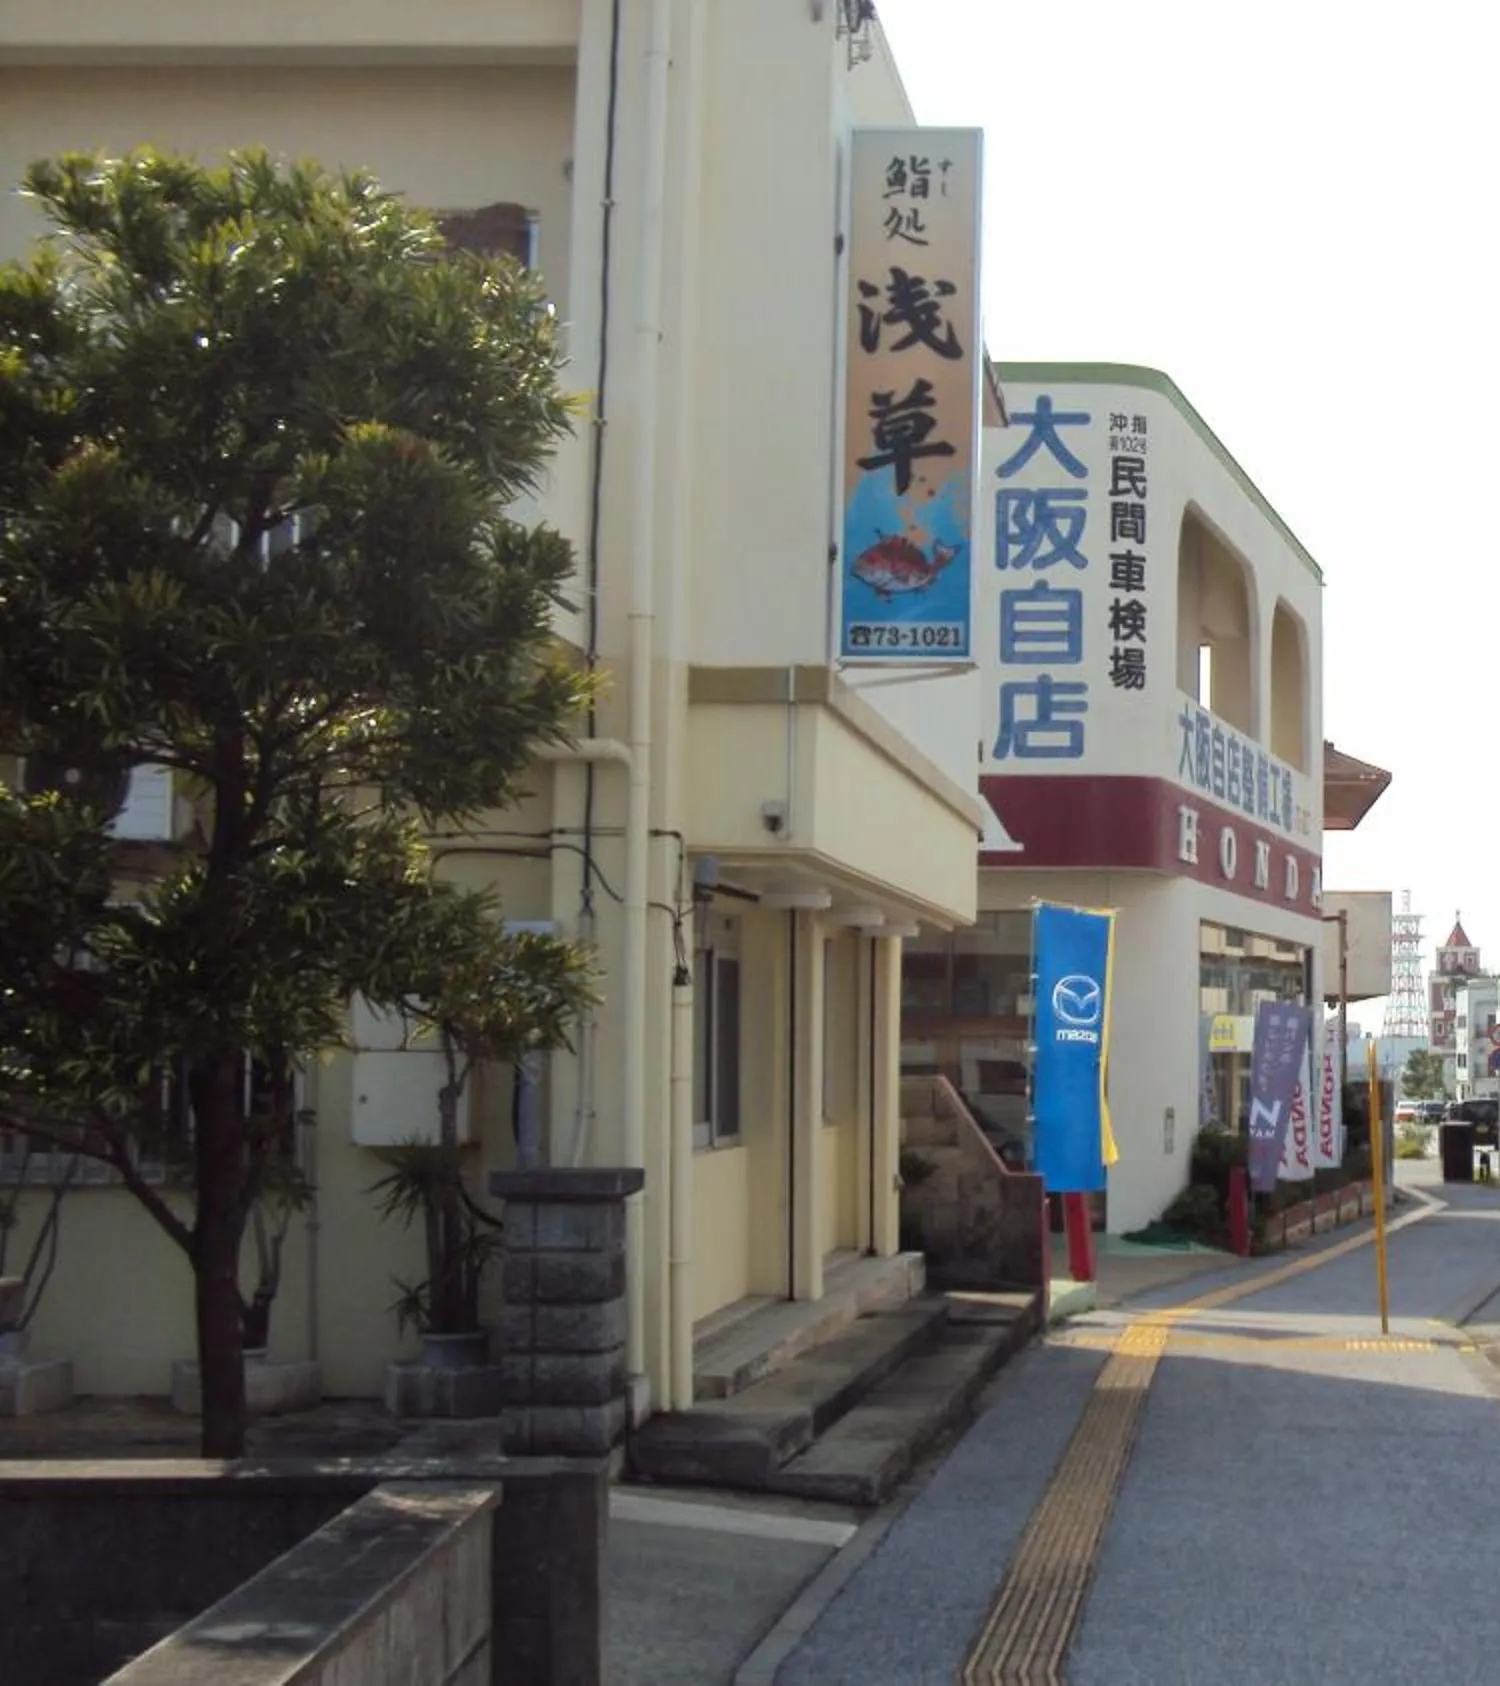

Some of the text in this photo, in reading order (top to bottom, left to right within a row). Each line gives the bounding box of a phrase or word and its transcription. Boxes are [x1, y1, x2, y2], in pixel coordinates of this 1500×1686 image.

[881, 153, 932, 247] 鮨処
[855, 265, 964, 497] 浅草
[873, 625, 960, 647] 73-1021
[992, 394, 1092, 761] 大阪自店
[1107, 455, 1148, 692] 民間車検場
[1178, 803, 1323, 912] HONDA
